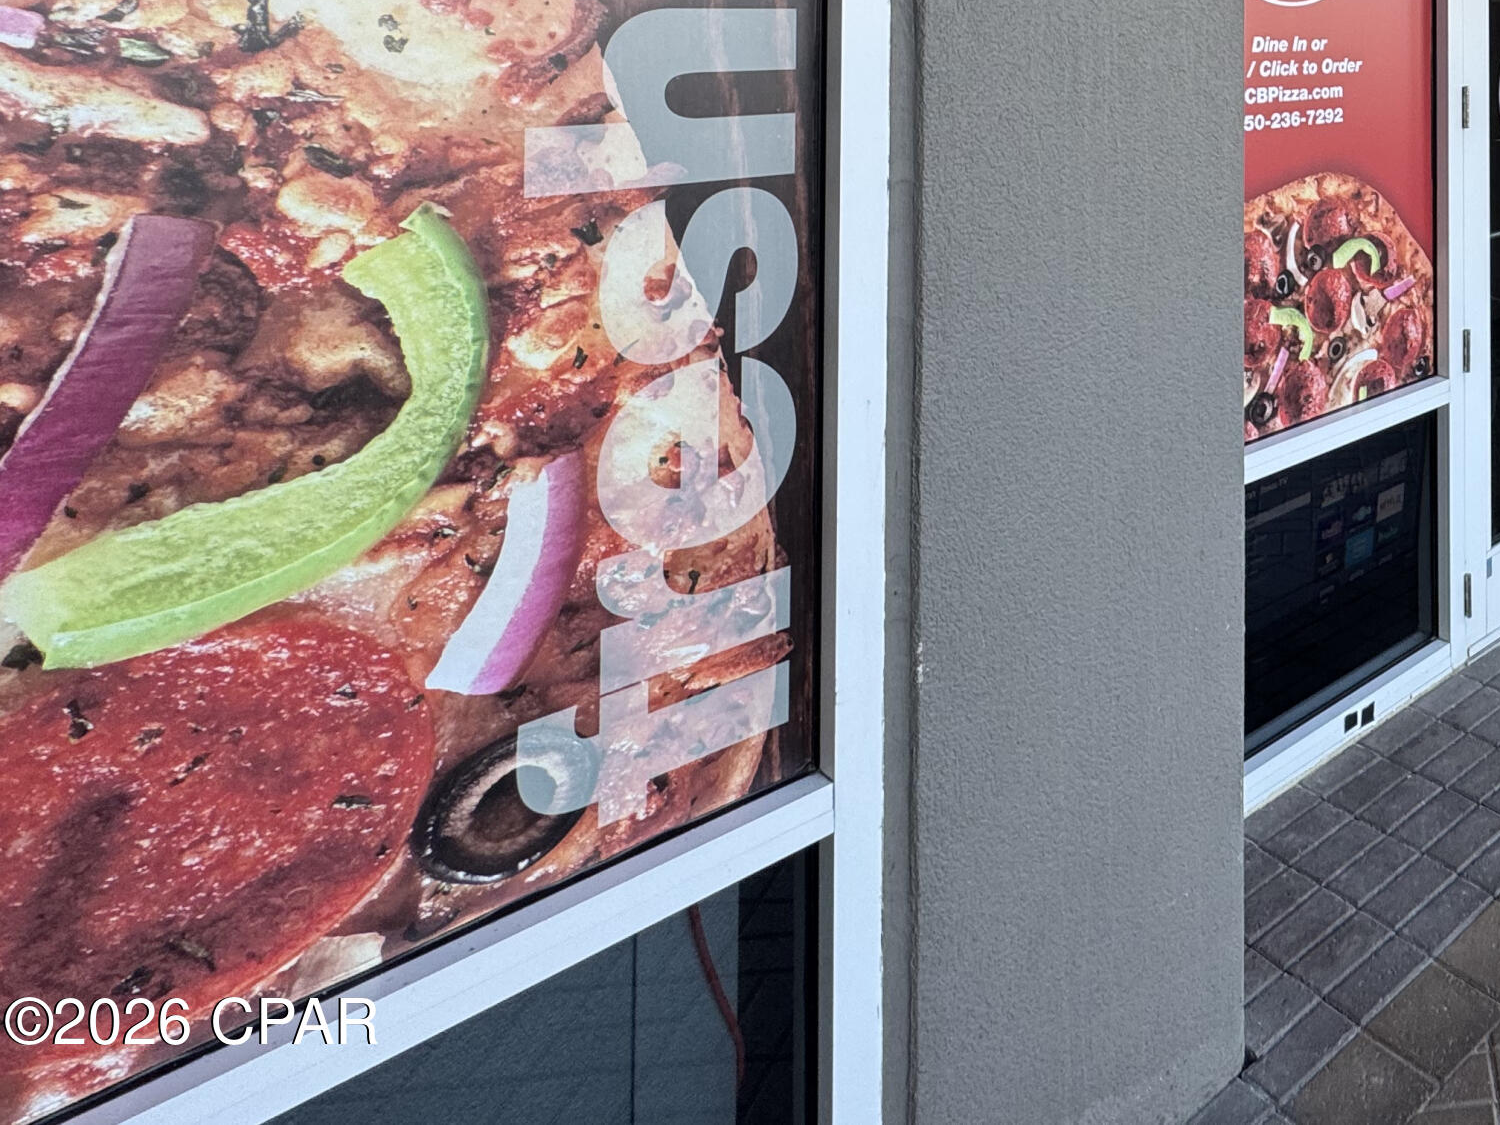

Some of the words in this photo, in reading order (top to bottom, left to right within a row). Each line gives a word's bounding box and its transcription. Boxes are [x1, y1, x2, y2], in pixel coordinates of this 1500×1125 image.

[1251, 35, 1288, 53] Dine
[1292, 35, 1307, 52] In
[1311, 38, 1328, 51] or
[1246, 61, 1256, 78] /
[1260, 59, 1299, 77] Click
[1302, 60, 1318, 75] to
[1321, 57, 1363, 74] Order
[515, 7, 797, 827] fresh
